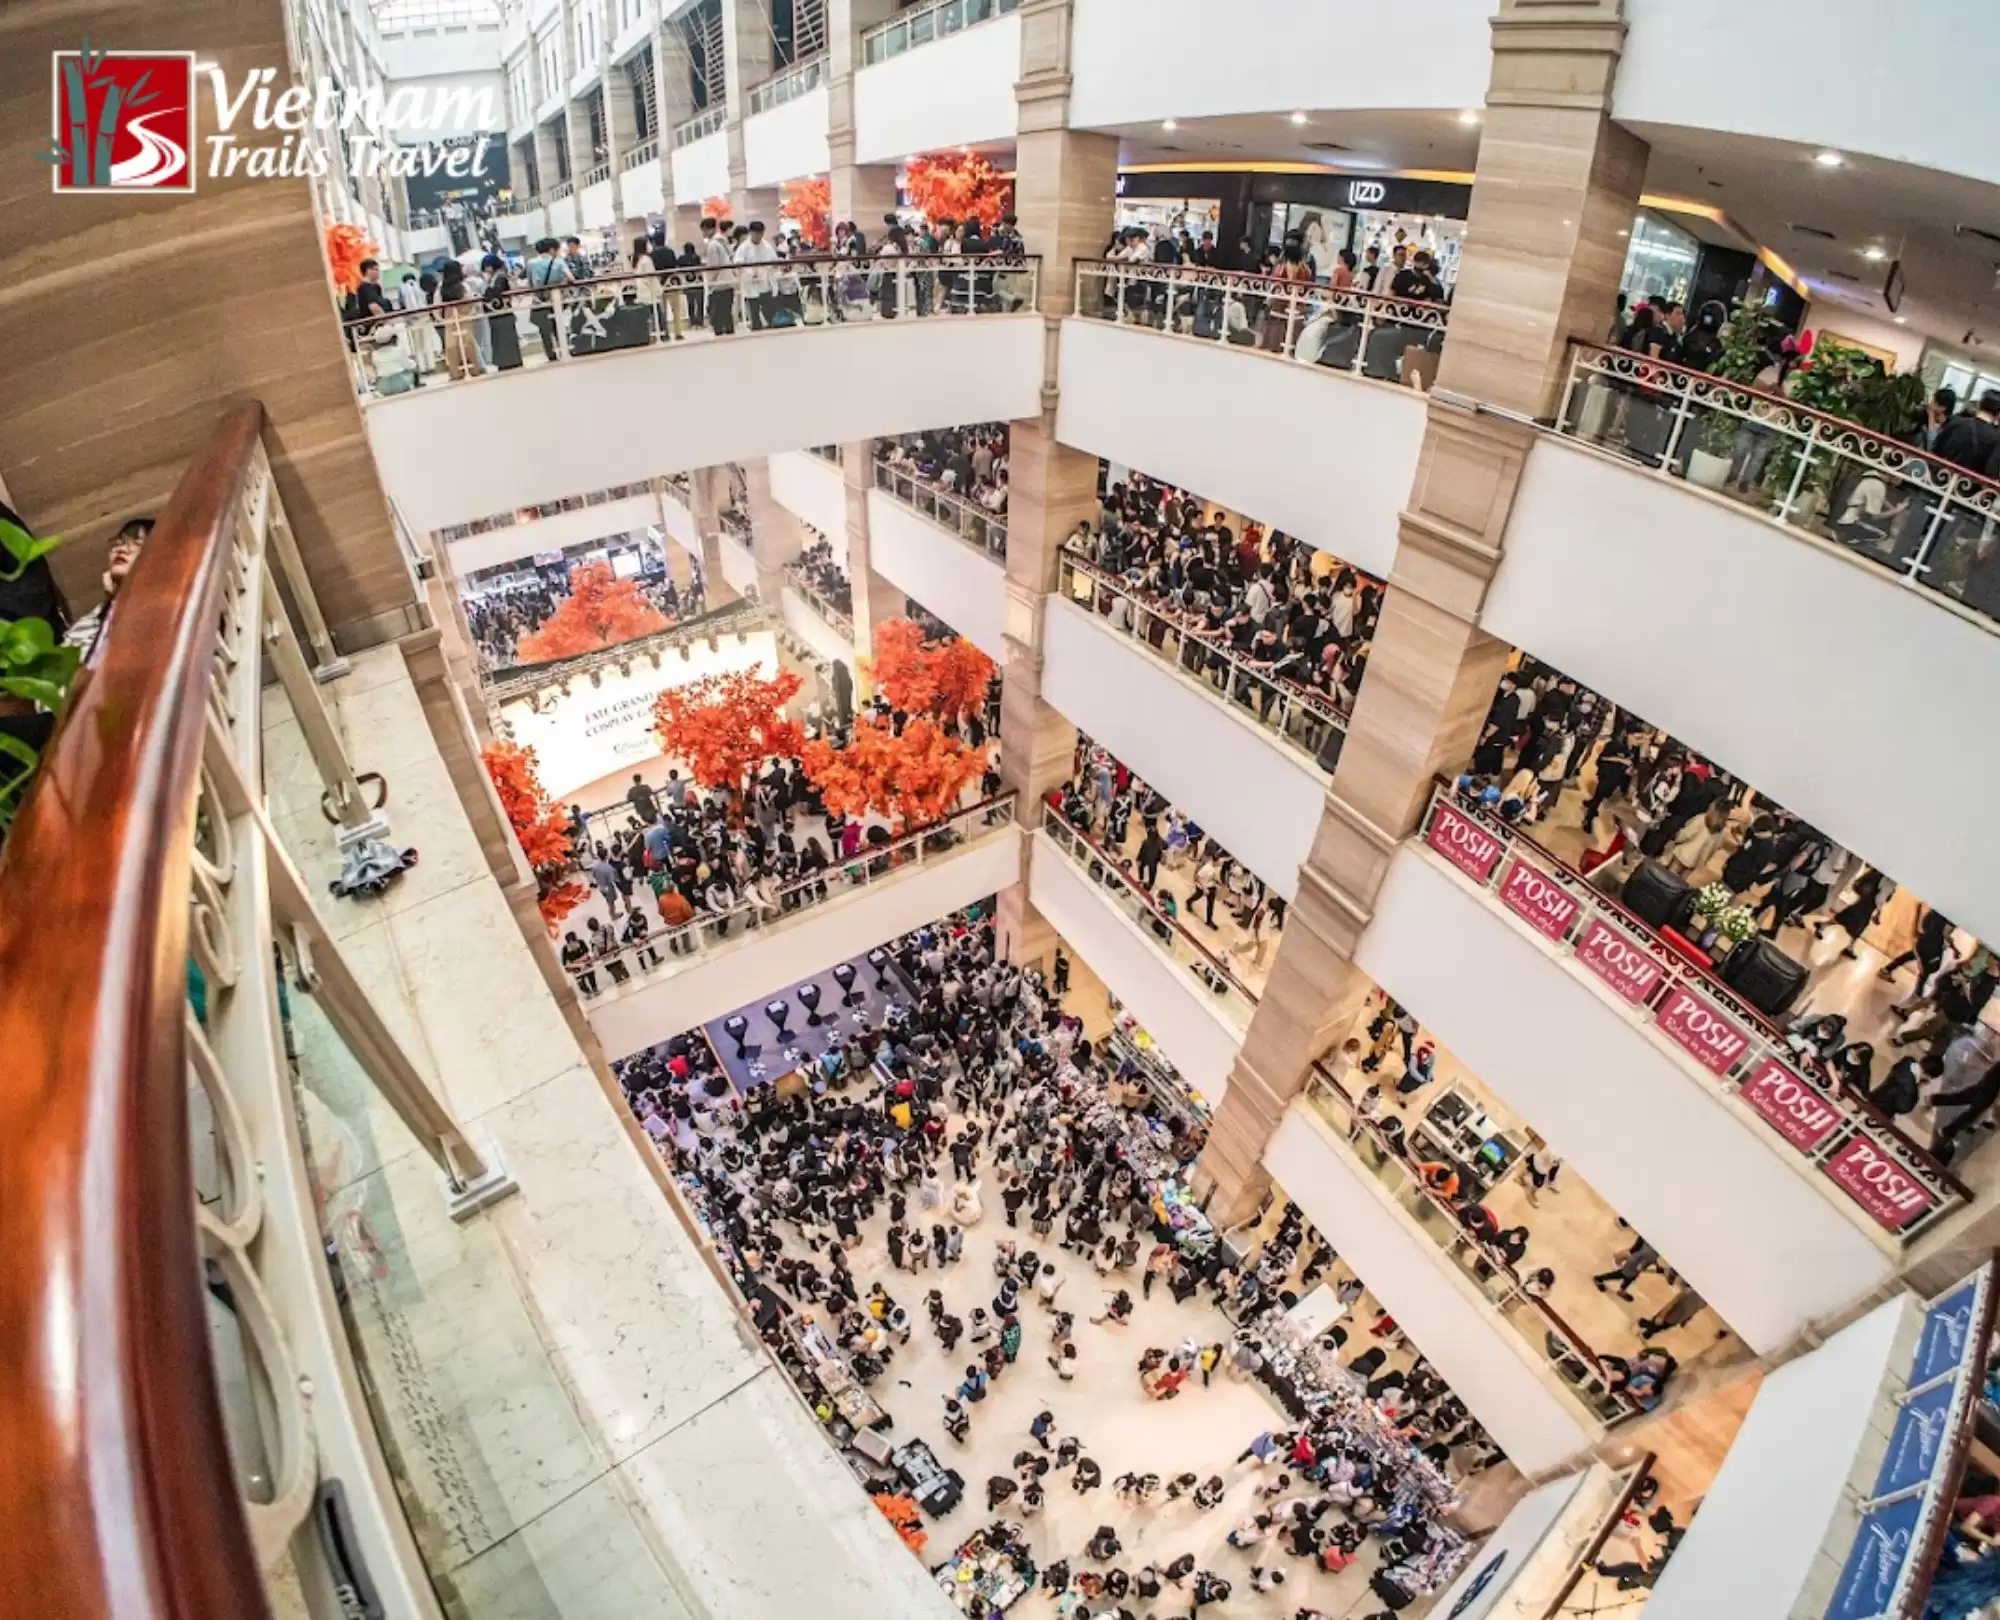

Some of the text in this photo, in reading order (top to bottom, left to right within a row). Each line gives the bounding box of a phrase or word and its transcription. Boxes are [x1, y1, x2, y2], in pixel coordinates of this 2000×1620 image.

[1439, 812, 1496, 862] POSH
[1511, 866, 1574, 921] POSH
[1589, 926, 1658, 986] POSH
[1672, 995, 1744, 1057] POSH
[1758, 1067, 1835, 1130] POSH
[1846, 1144, 1925, 1211] POSH
